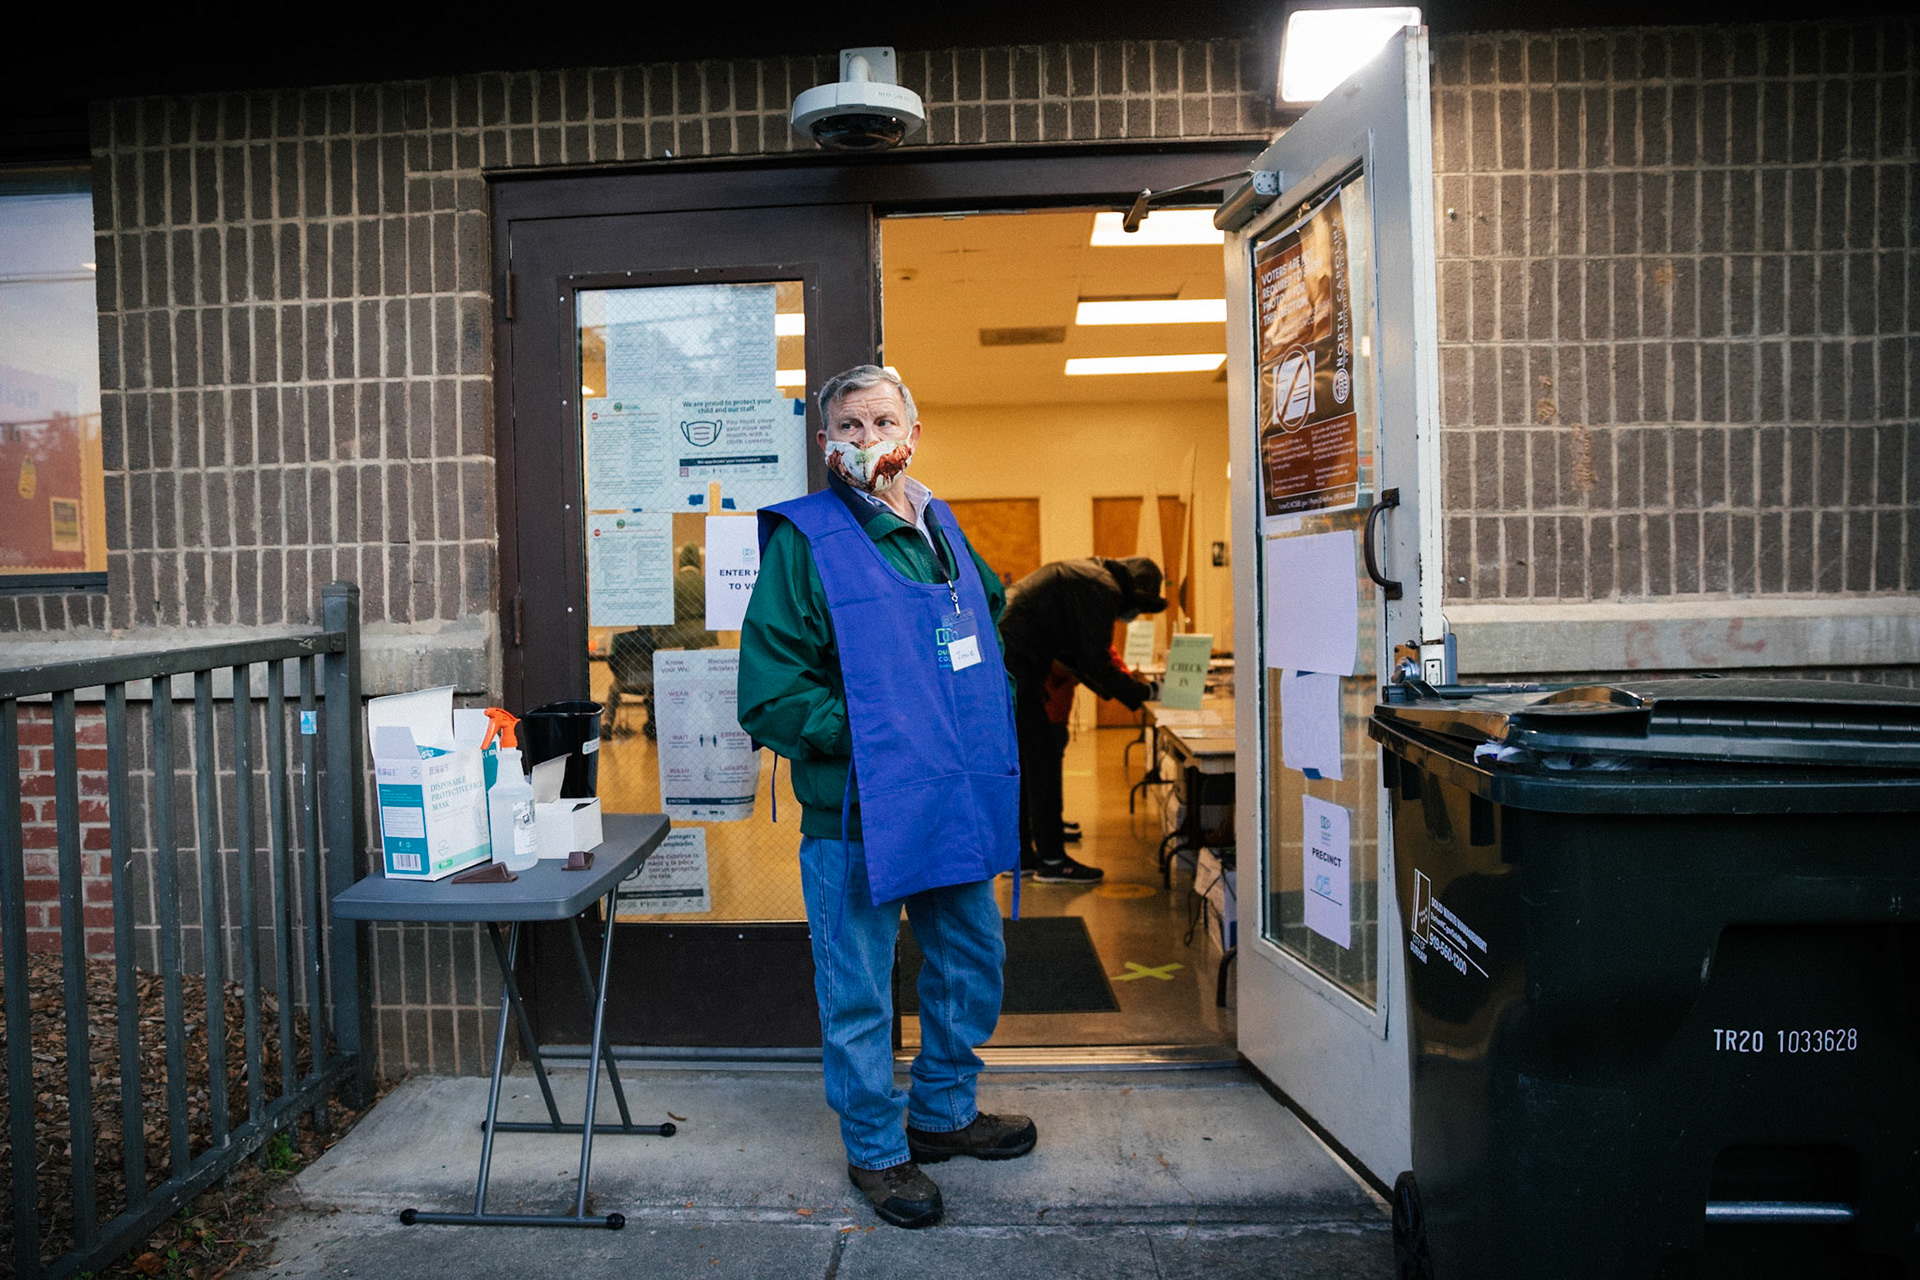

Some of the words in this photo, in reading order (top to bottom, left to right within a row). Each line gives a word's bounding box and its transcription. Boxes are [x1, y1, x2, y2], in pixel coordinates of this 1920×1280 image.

[1331, 217, 1343, 303] CAROLINA
[1262, 264, 1288, 286] VOTERS
[1288, 255, 1301, 271] ARE
[1294, 269, 1302, 283] TO
[1263, 293, 1285, 313] PHOTO
[1295, 281, 1306, 295] FOR
[1336, 311, 1345, 369] NORTH
[705, 400, 724, 408] proud
[733, 399, 756, 407] protect
[719, 569, 751, 577] ENTER
[729, 583, 742, 591] TO
[1171, 663, 1203, 674] CHECK
[1179, 678, 1189, 687] IN
[430, 776, 466, 792] DISPOSABLE
[431, 784, 470, 802] PROTECTIVE
[469, 780, 484, 791] FACE
[432, 801, 450, 811] MASK
[1312, 847, 1342, 868] PRECINCT
[1713, 1029, 1764, 1053] TR20
[1777, 1029, 1858, 1053] 1033628
